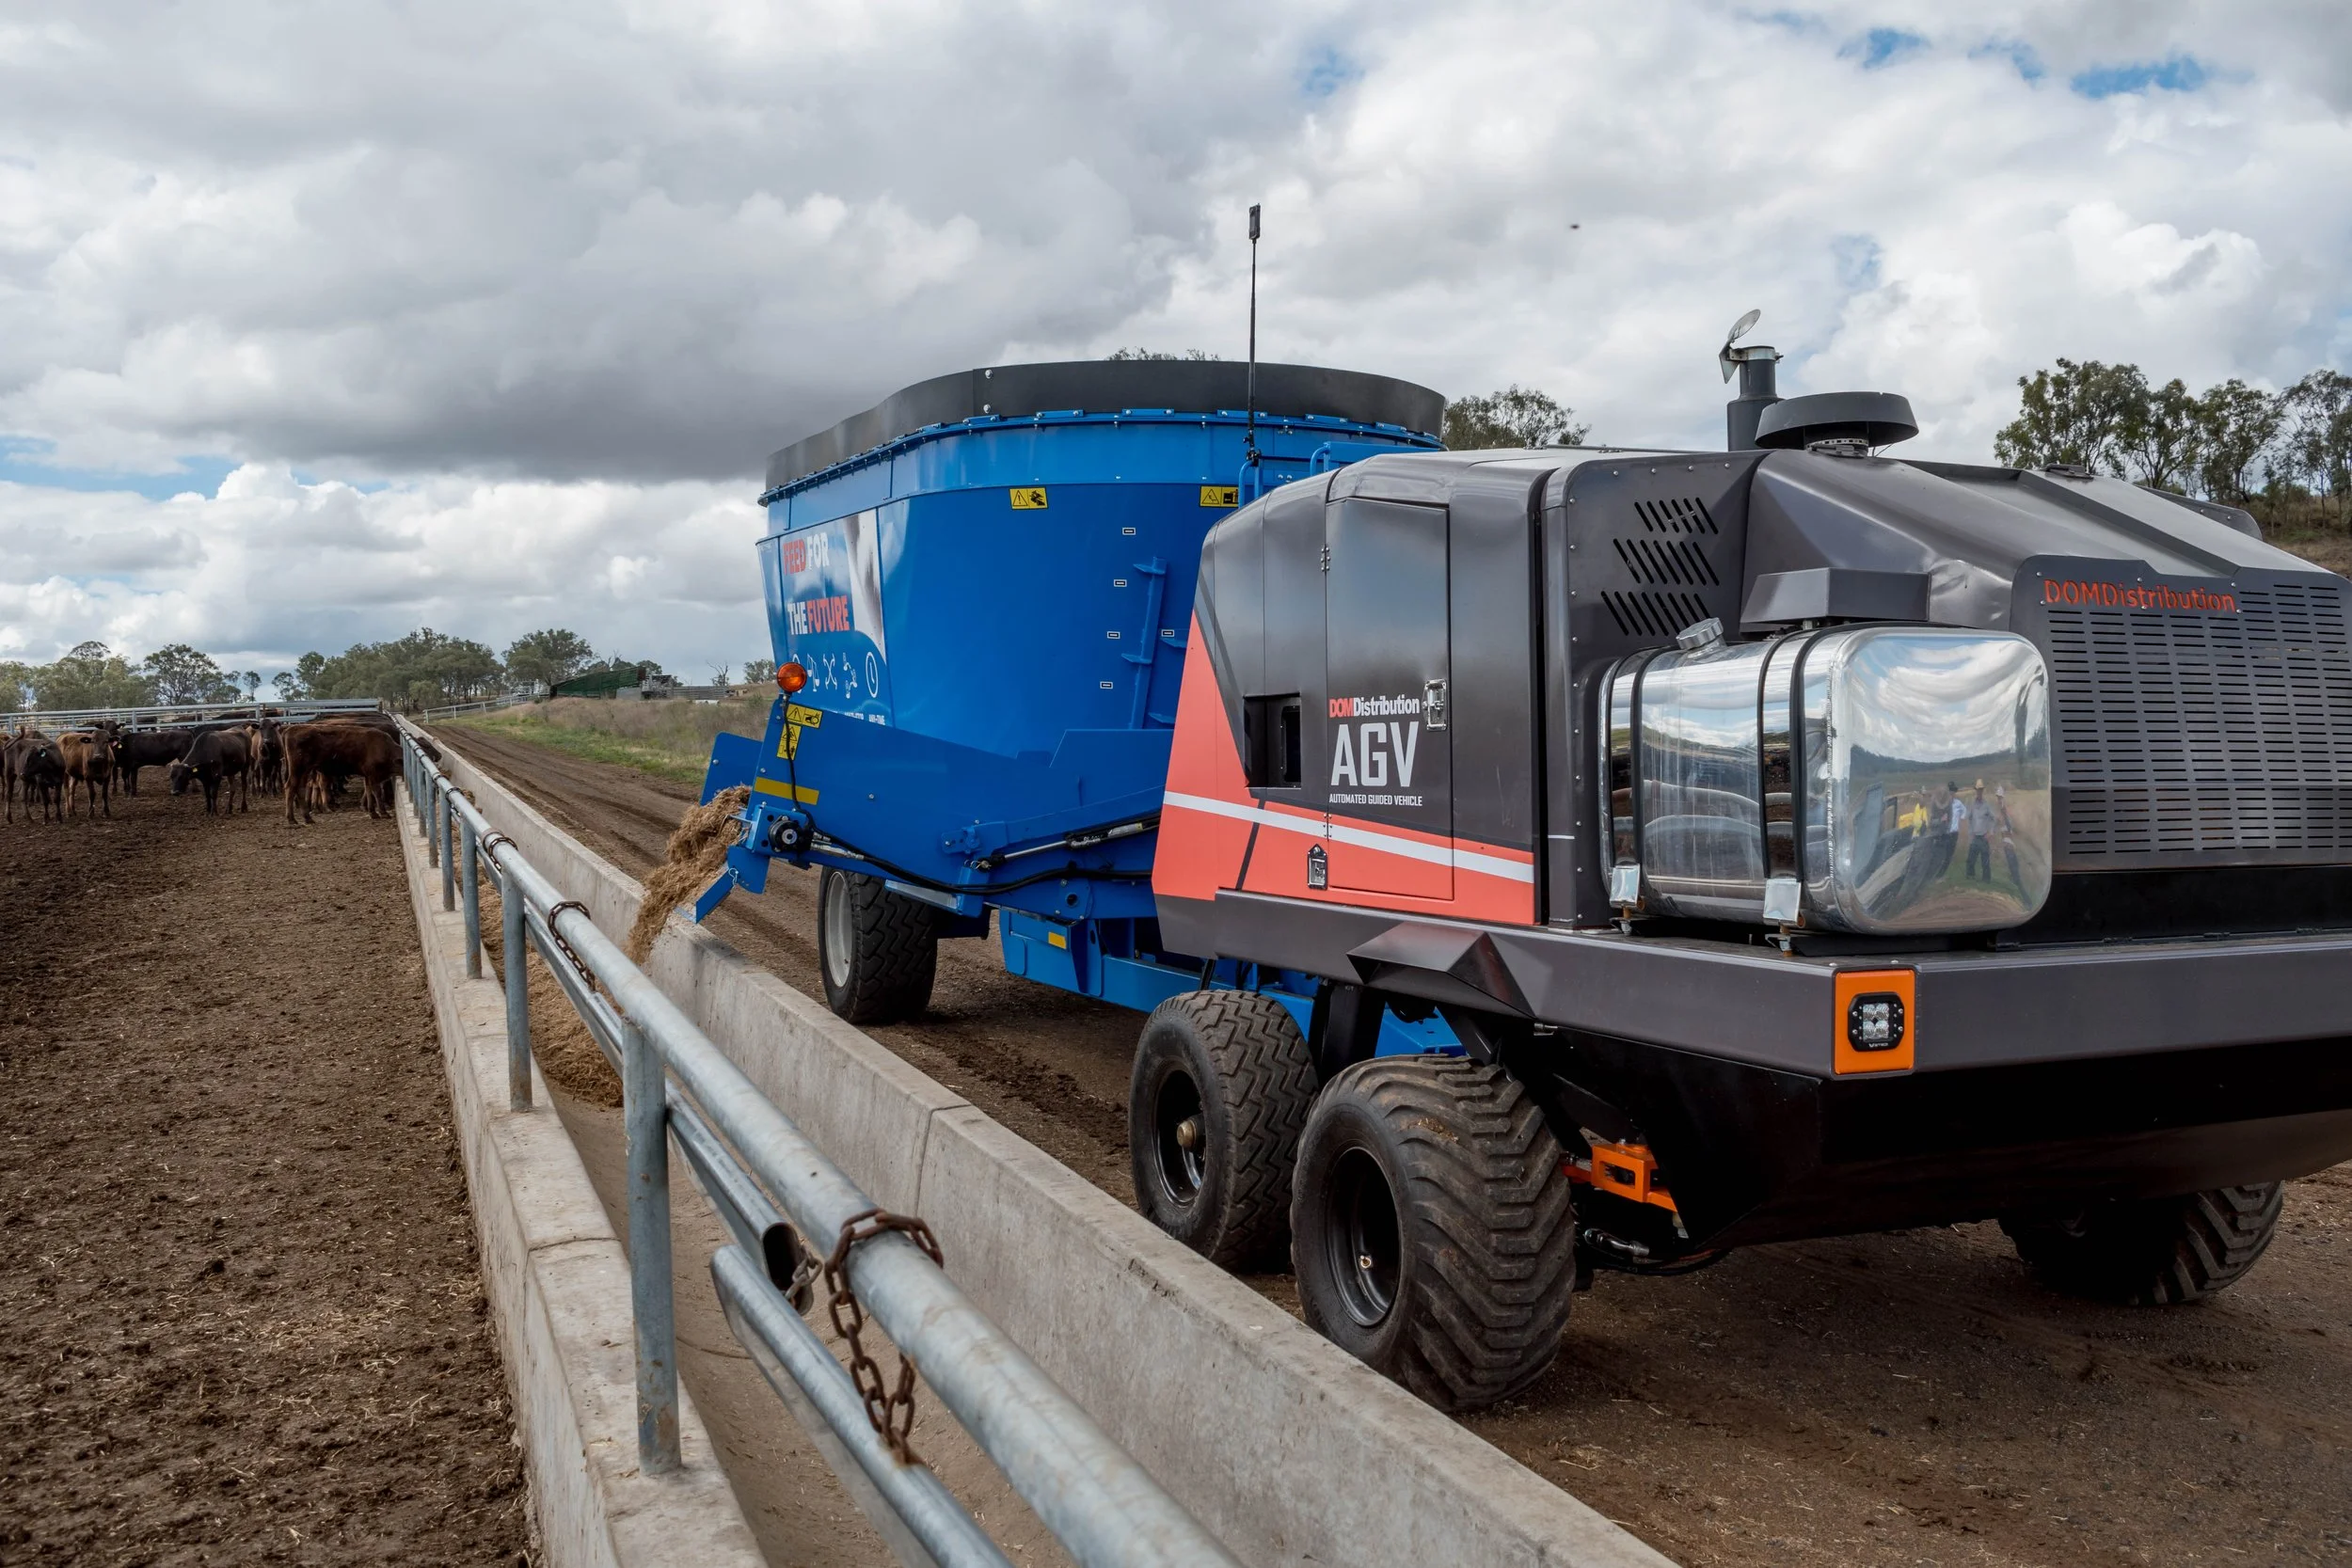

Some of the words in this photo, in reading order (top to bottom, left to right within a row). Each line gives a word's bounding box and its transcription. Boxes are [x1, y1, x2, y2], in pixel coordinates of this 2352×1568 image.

[783, 538, 806, 576] FEED
[807, 532, 830, 571] FOR
[2043, 578, 2235, 612] DOMDistribution
[787, 601, 808, 635] THE
[806, 594, 850, 634] FUTURE
[1329, 694, 1421, 718] DOMDistribution
[1330, 721, 1419, 787] AGV
[1329, 793, 1366, 804] AUTOMATED
[1368, 794, 1392, 805] GUIDED
[1393, 796, 1422, 807] VEHICLE
